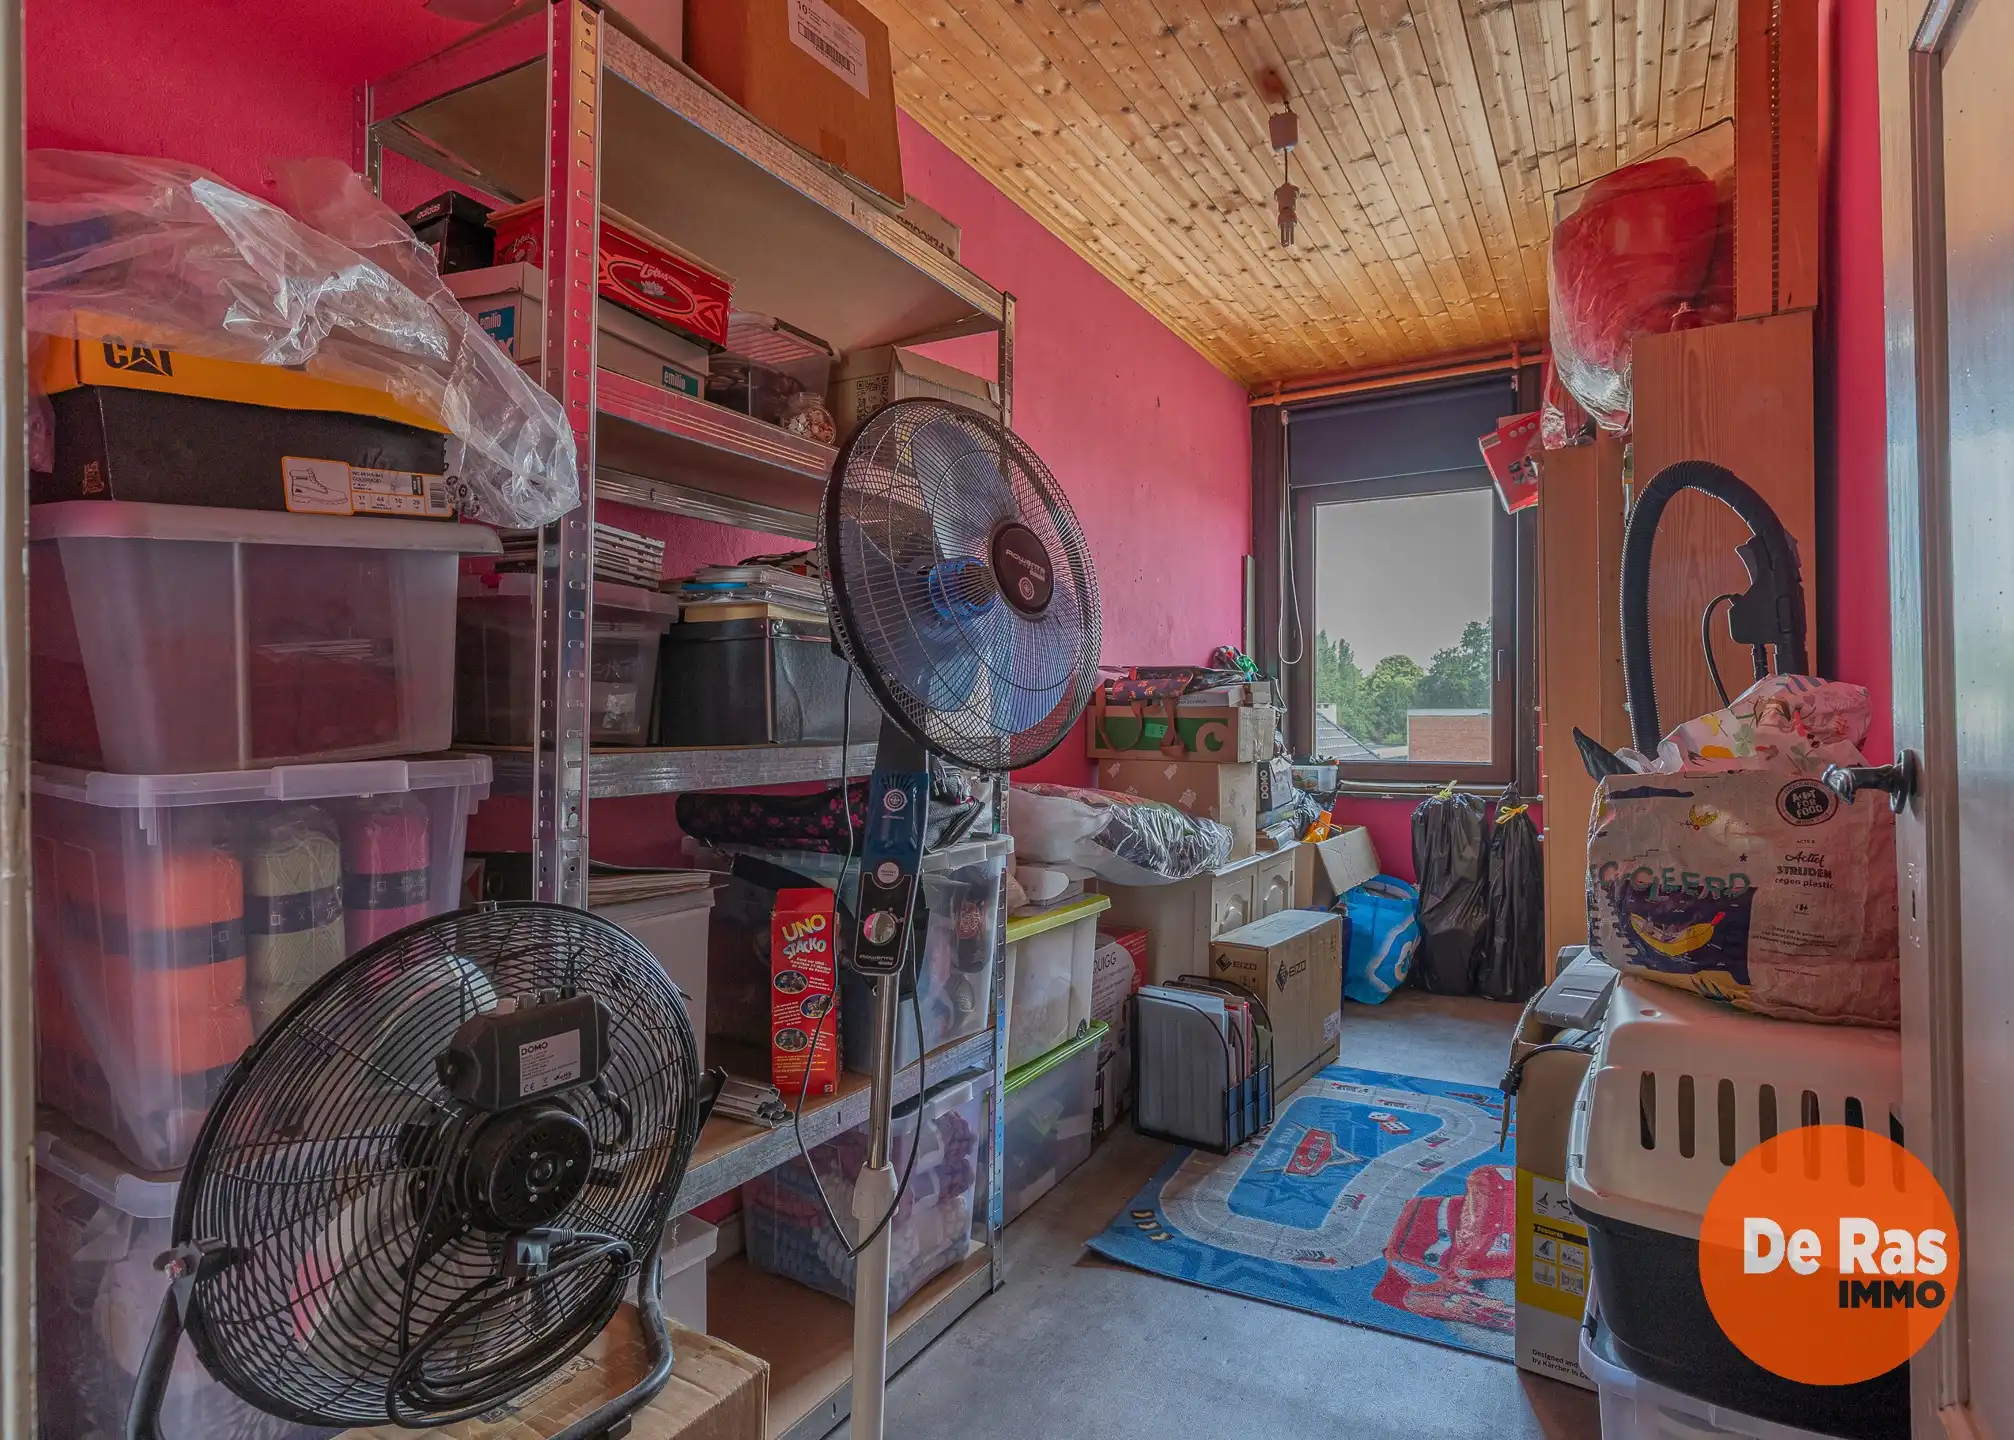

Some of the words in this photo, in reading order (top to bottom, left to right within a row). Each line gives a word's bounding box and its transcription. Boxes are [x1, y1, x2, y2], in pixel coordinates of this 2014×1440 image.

[416, 203, 441, 219] adidas
[639, 263, 669, 281] Lotus
[479, 312, 502, 330] emilio
[102, 334, 177, 377] CAT
[664, 371, 686, 390] emilio
[1259, 769, 1269, 800] DOMO
[1796, 804, 1823, 818] FOOD
[1797, 799, 1817, 809] FOR
[1803, 879, 1834, 889] plastic
[782, 914, 826, 941] UNO
[783, 937, 827, 960] STACKO
[1232, 960, 1258, 971] EIZO
[1288, 959, 1307, 978] EIZO
[521, 1041, 548, 1056] DOMO
[1532, 1349, 1564, 1366] Designed
[1564, 1359, 1579, 1368] and
[1532, 1357, 1542, 1367] by
